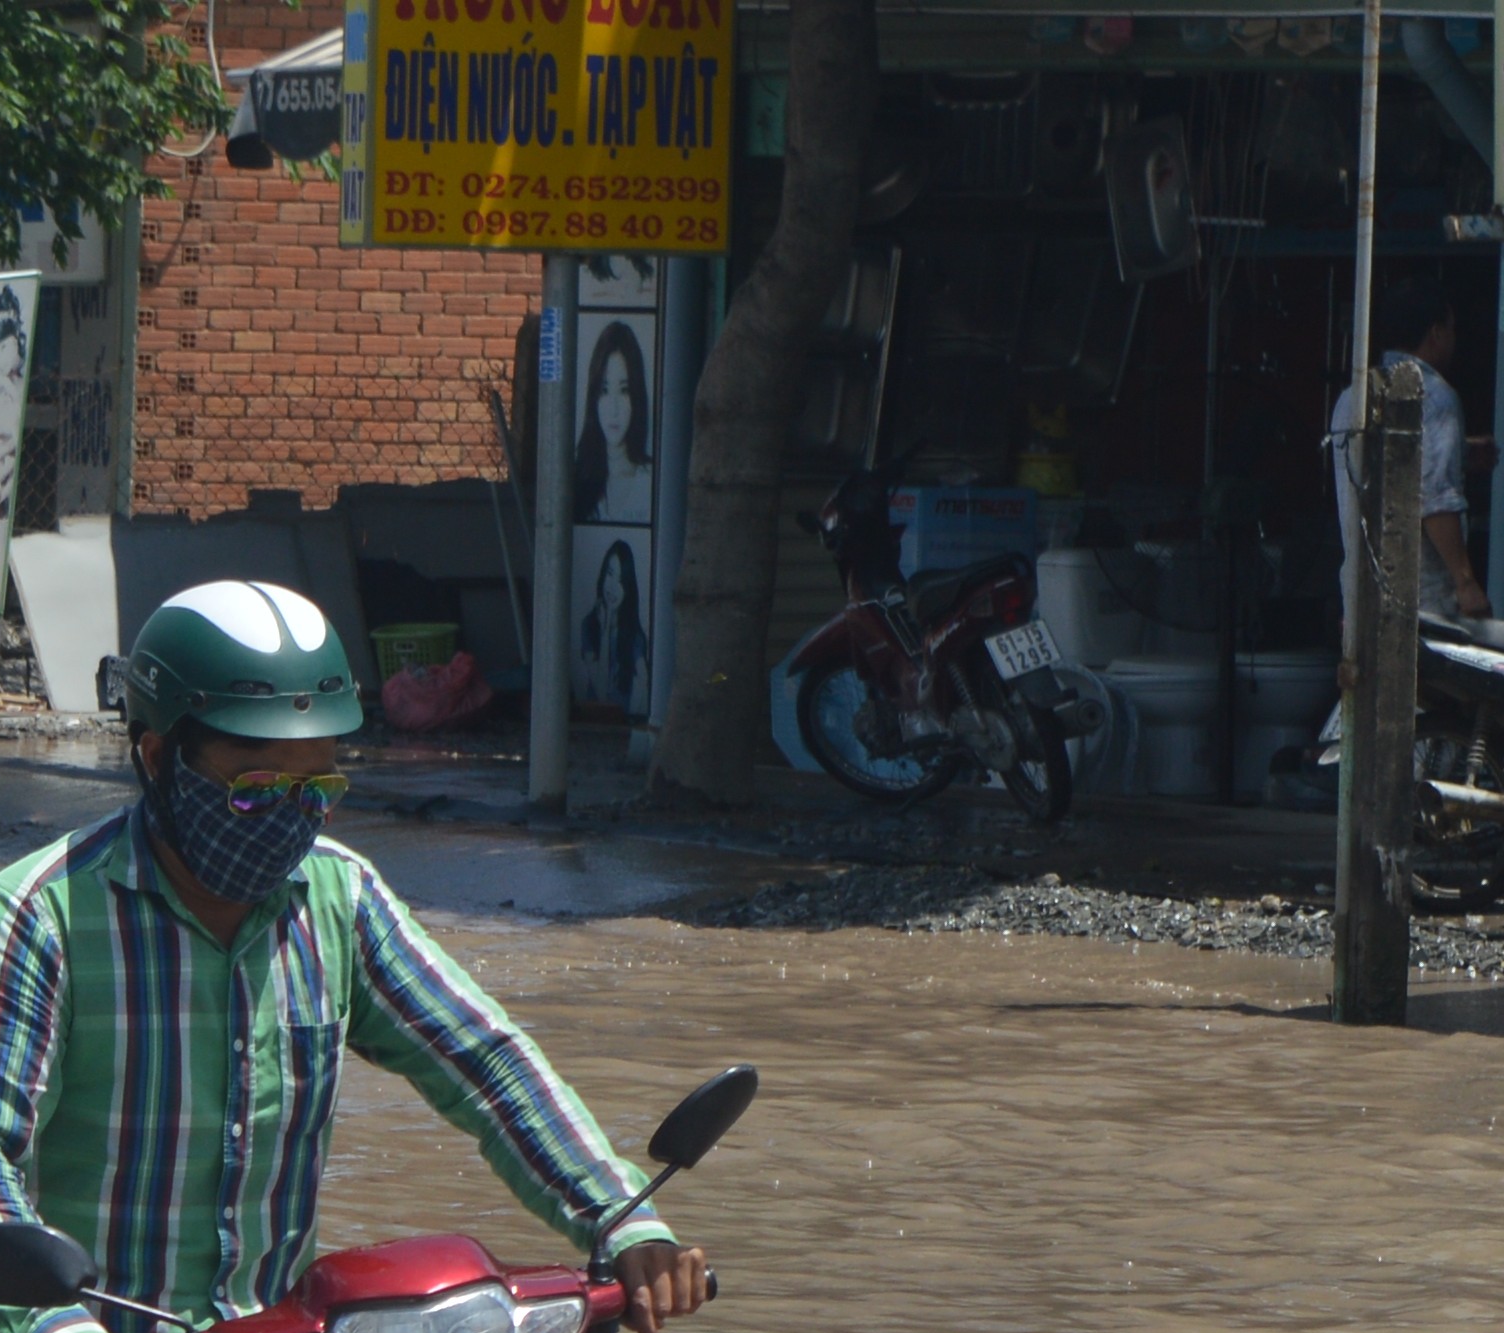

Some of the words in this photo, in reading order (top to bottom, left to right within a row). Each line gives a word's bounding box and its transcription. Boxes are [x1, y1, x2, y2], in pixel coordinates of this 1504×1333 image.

[384, 31, 460, 155] ĐIỆN
[467, 31, 559, 148] NƯỚC
[586, 54, 648, 160] TẠP
[653, 41, 719, 160] VẬT
[384, 170, 446, 198] ĐT:
[461, 172, 722, 203] 0274.6522399
[384, 208, 446, 235] DĐ:
[620, 214, 664, 241] 40
[677, 216, 719, 243] 28
[1005, 644, 1053, 673] 1295
